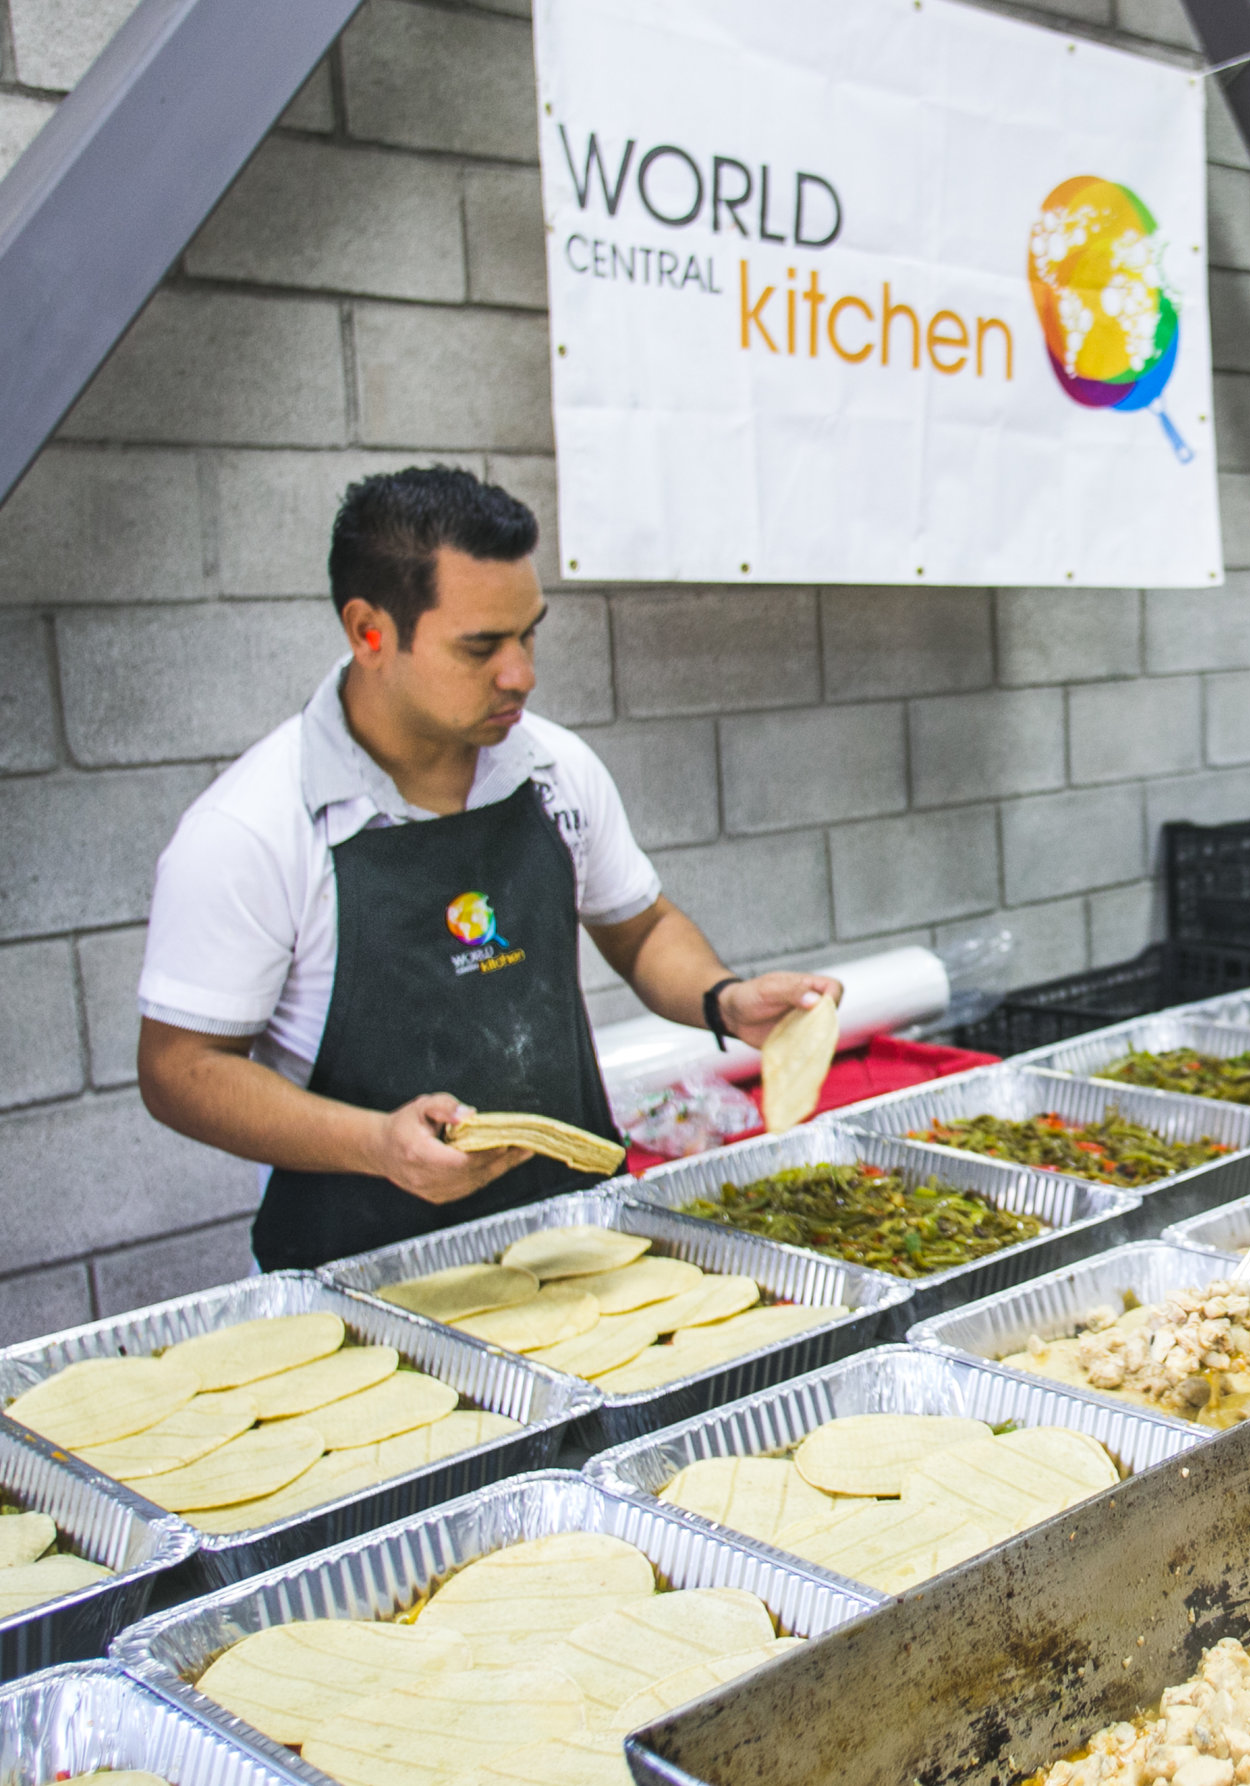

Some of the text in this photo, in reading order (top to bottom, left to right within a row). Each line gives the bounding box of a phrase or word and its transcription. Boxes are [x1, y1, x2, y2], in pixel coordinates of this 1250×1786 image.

[558, 123, 843, 249] WORLD
[565, 233, 723, 295] CENTRAL
[740, 259, 1014, 382] kitchen
